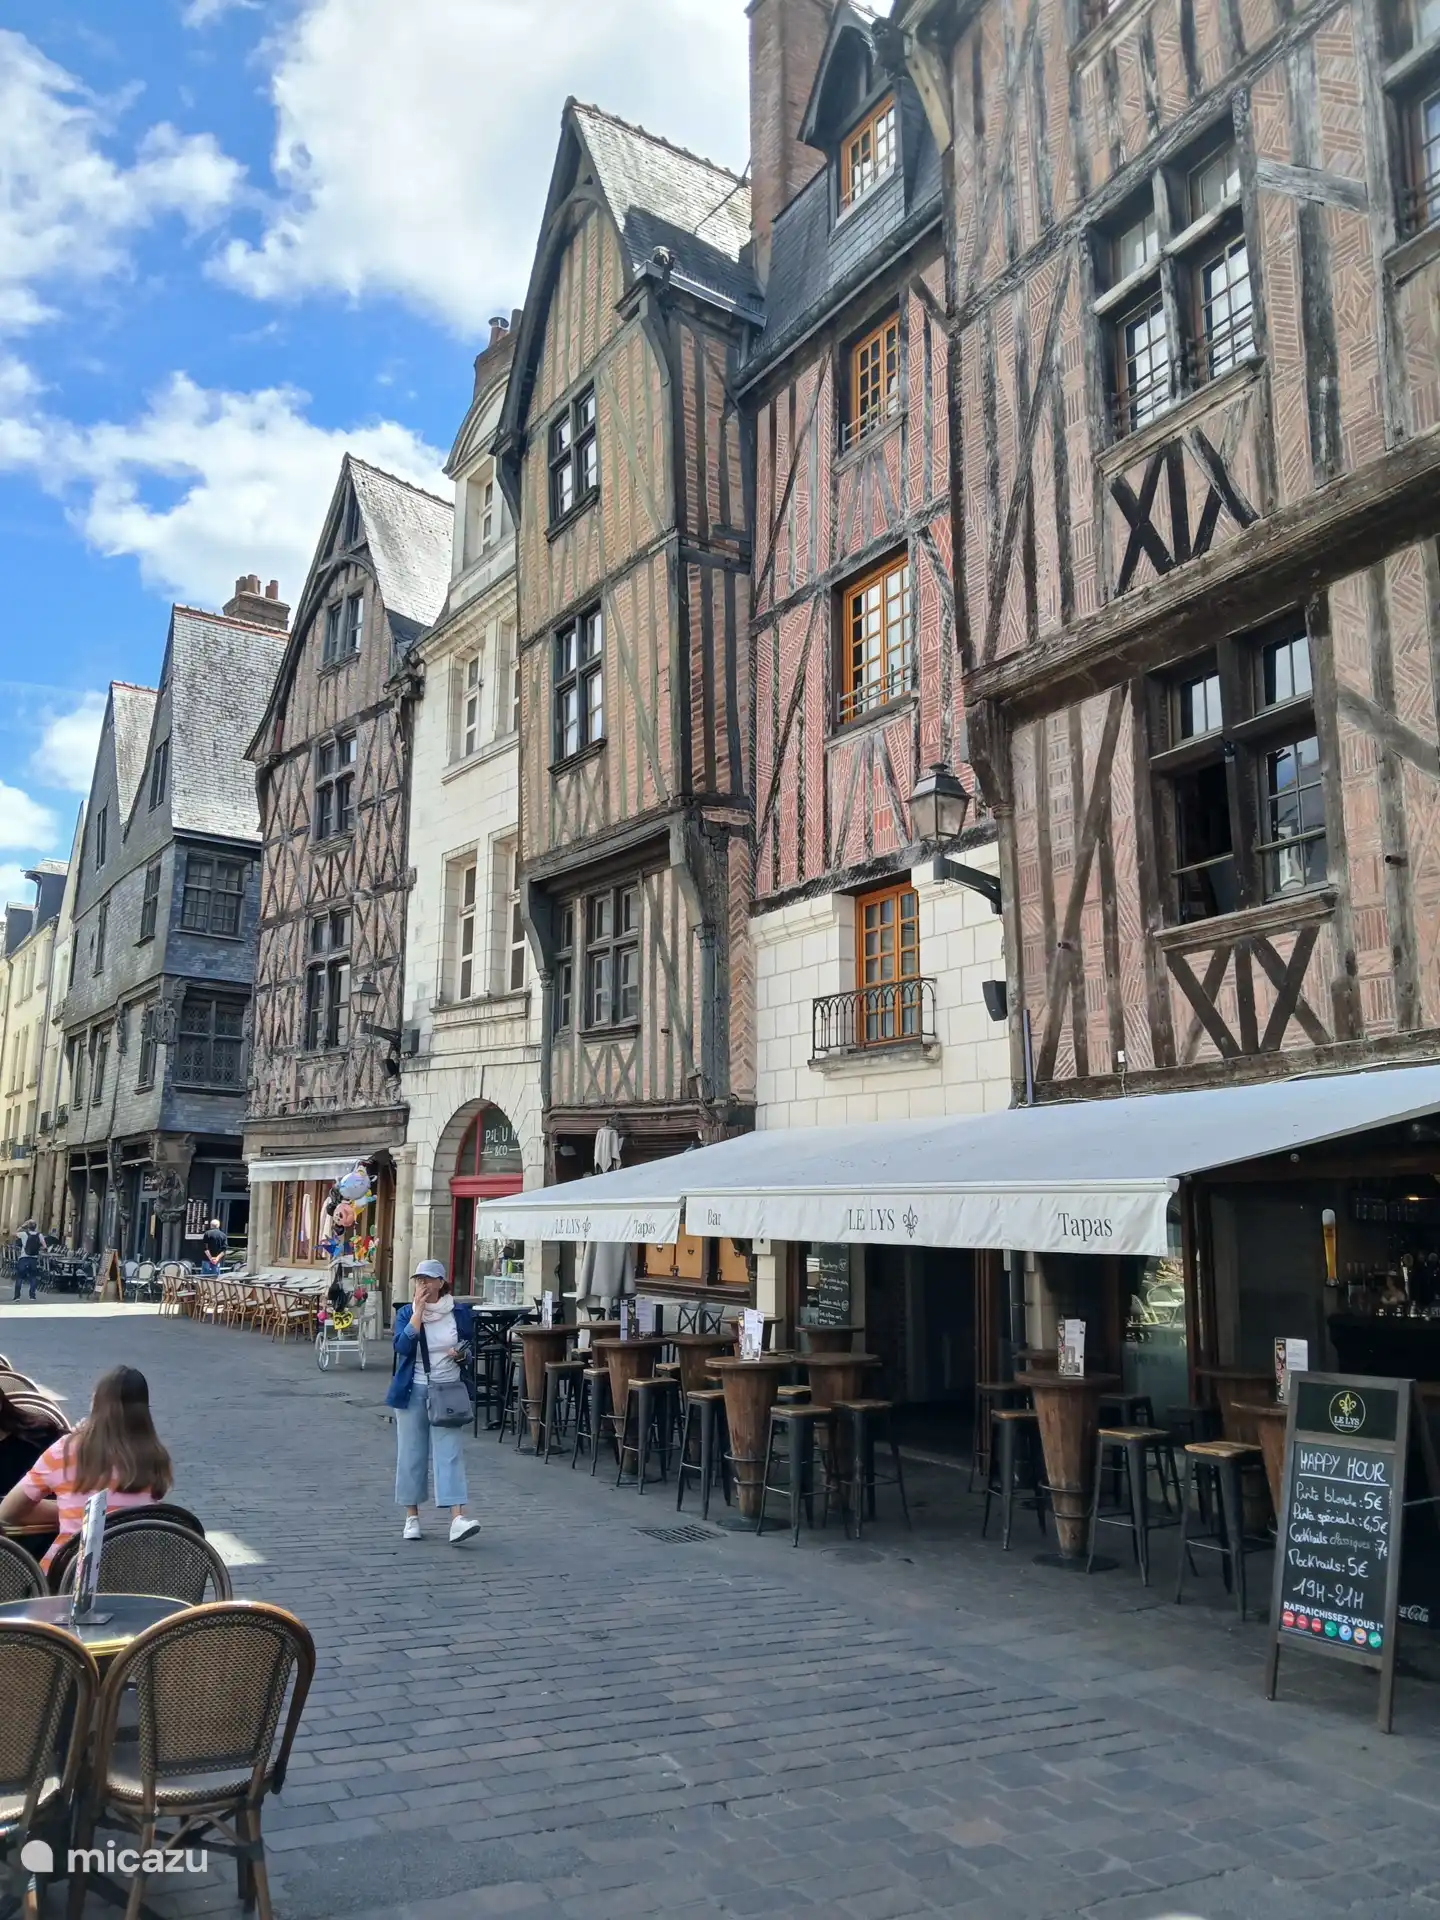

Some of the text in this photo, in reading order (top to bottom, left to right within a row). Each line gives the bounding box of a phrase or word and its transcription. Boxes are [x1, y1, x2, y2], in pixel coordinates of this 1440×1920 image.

[566, 1218, 581, 1234] LYS
[707, 1208, 721, 1226] Bar
[848, 1208, 895, 1231] LE LYS
[1057, 1212, 1113, 1242] Tapas
[633, 1219, 656, 1237] Tapas
[1334, 1415, 1360, 1426] LE LYS
[1300, 1449, 1386, 1482] HAPPY HOUR
[1347, 1557, 1369, 1578] 5€
[1283, 1601, 1375, 1630] RAFRAICHISSEZ-VOUS
